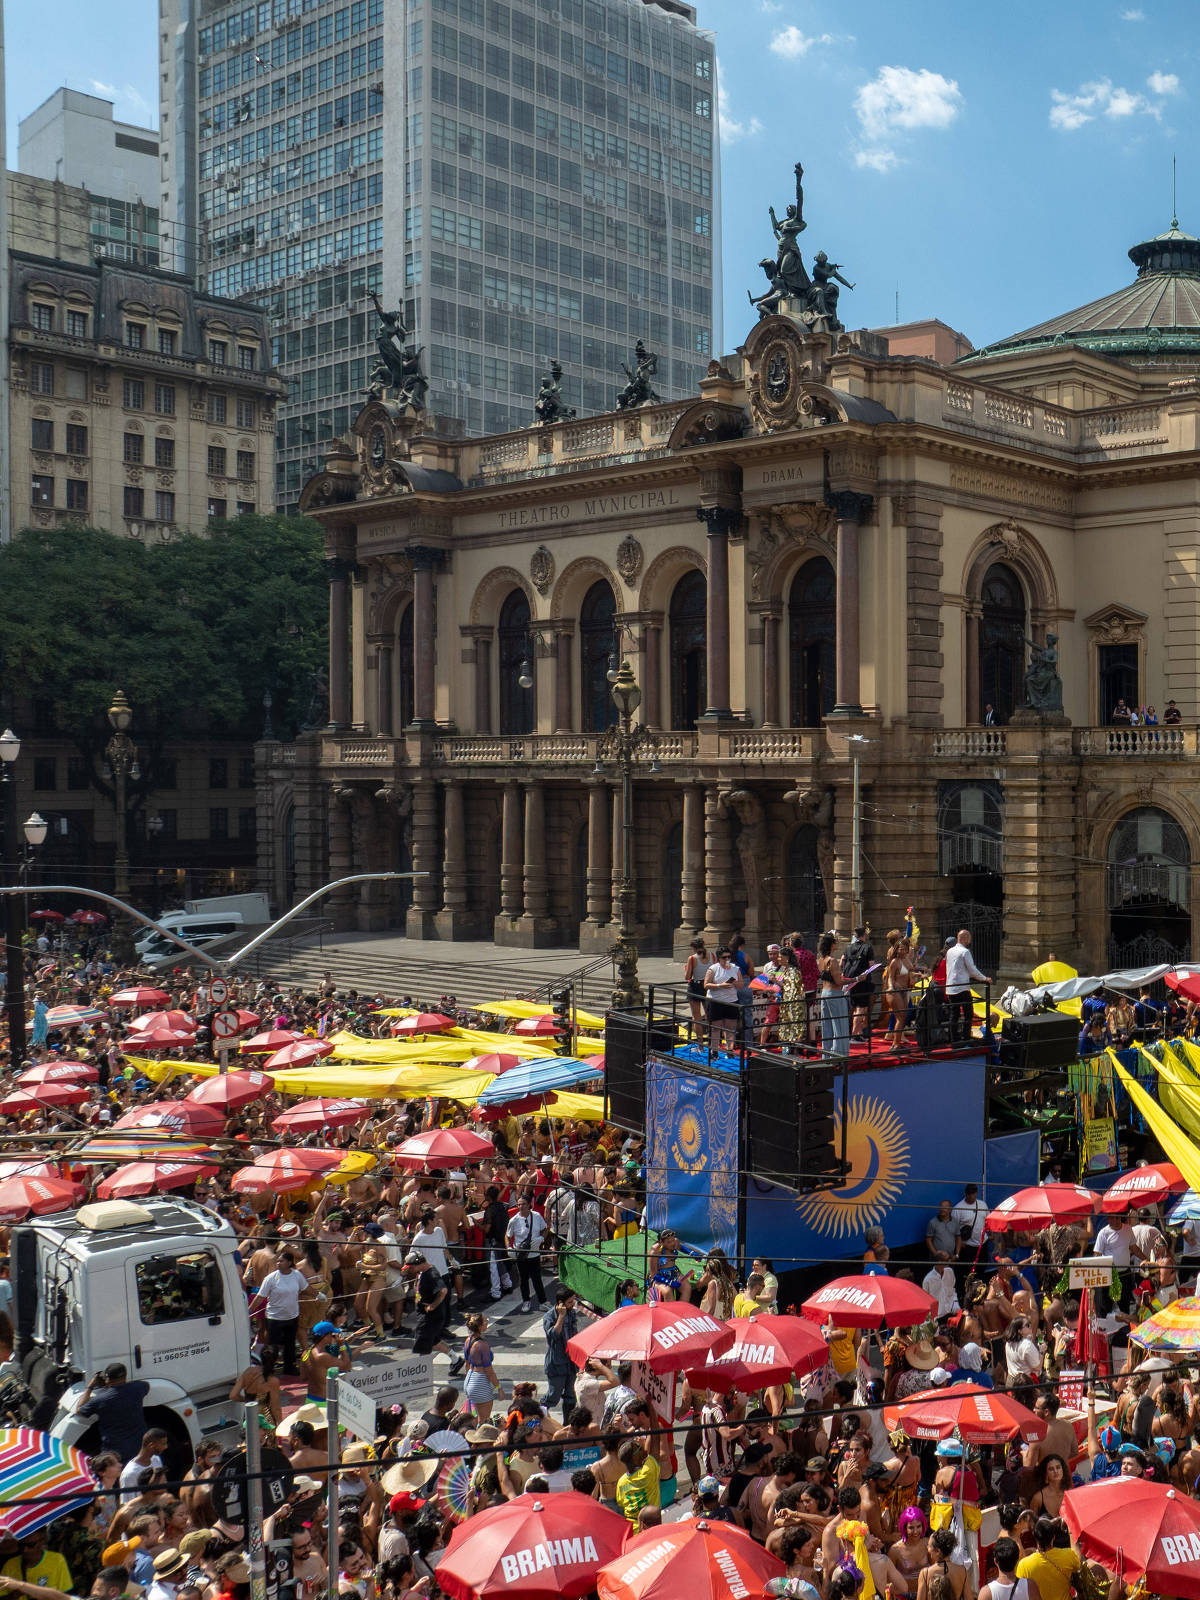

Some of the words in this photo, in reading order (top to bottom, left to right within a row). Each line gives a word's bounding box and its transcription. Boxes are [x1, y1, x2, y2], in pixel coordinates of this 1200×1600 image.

[762, 467, 803, 483] DRAMA
[498, 504, 570, 528] THEATRO
[584, 489, 679, 516] MVNICIPAL
[1075, 1268, 1102, 1277] STILL
[1084, 1275, 1108, 1287] HERE
[815, 1288, 877, 1309] BRAHMA
[653, 1315, 722, 1349] BRAHMA
[153, 1356, 162, 1364] 11
[164, 1350, 189, 1362] 96052
[190, 1346, 210, 1356] 9864
[351, 1374, 379, 1388] Xavier
[382, 1371, 393, 1382] de
[396, 1363, 427, 1379] Toledo
[502, 1535, 599, 1583] BRAHMA
[622, 1540, 677, 1585] BRAHMA
[713, 1548, 750, 1600] BRAHMA
